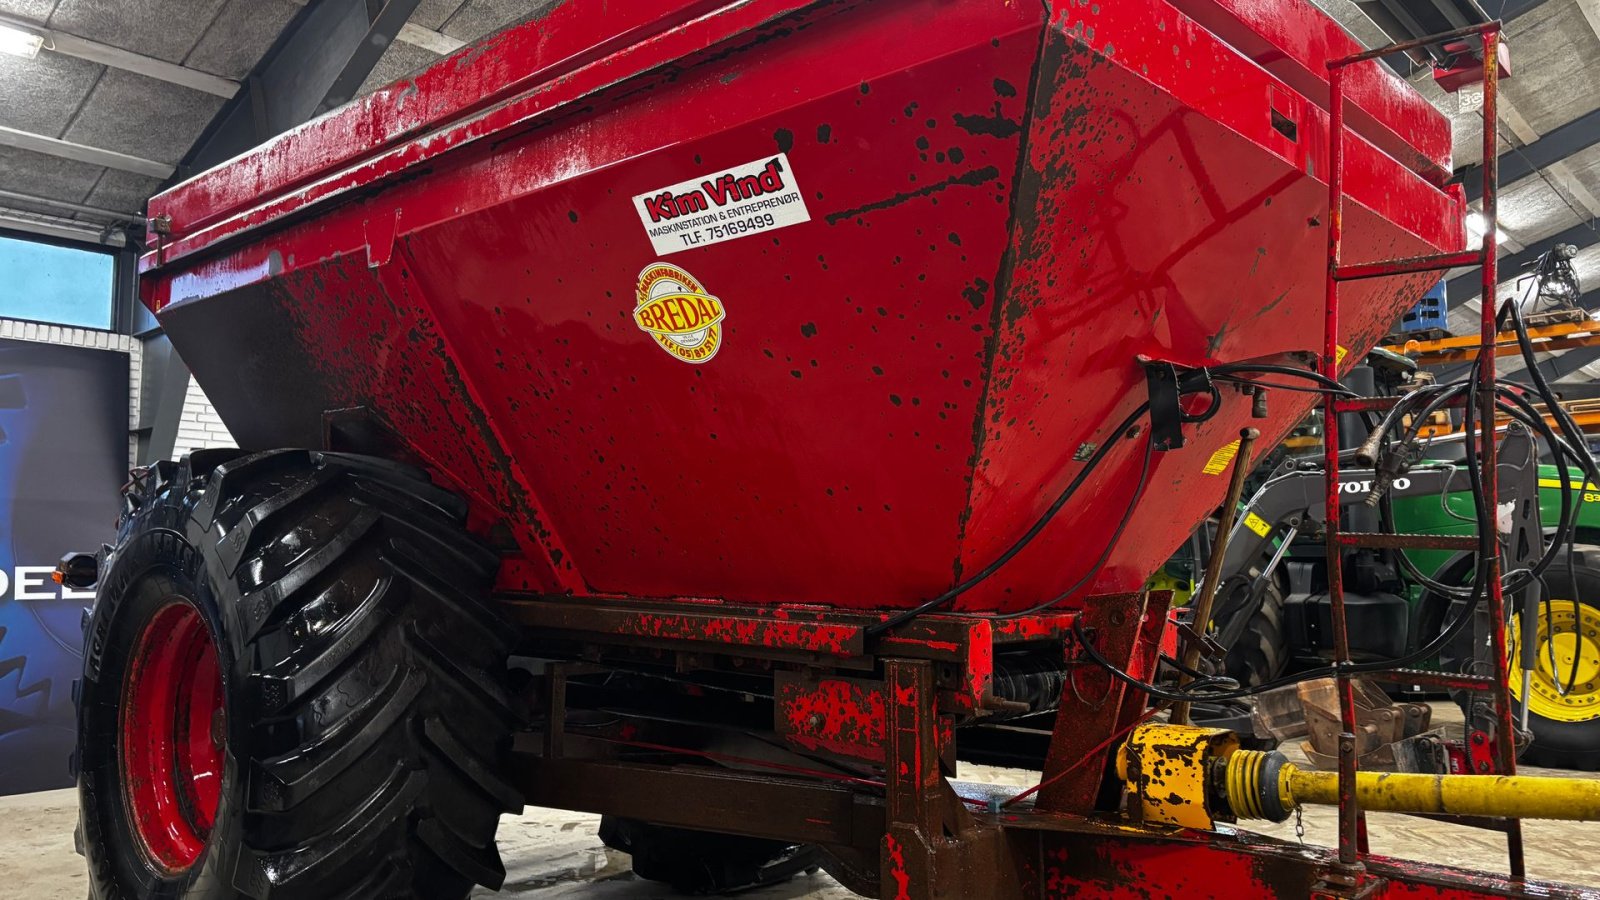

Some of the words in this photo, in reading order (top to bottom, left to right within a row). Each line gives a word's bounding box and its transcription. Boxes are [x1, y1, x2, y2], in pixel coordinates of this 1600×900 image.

[644, 190, 708, 223] Kim
[701, 159, 785, 207] Vind
[648, 213, 718, 237] MASKINSTATION
[719, 211, 727, 221] &
[728, 192, 800, 218] ENTREPRENØR
[680, 230, 706, 246] TLF.
[706, 213, 775, 240] 75169499
[641, 267, 698, 293] MASKINFABRIKEN
[639, 297, 720, 332] BREDAL
[660, 335, 676, 353] TLF.
[676, 345, 694, 359] (05)
[694, 347, 706, 358] 89
[708, 327, 717, 342] 77
